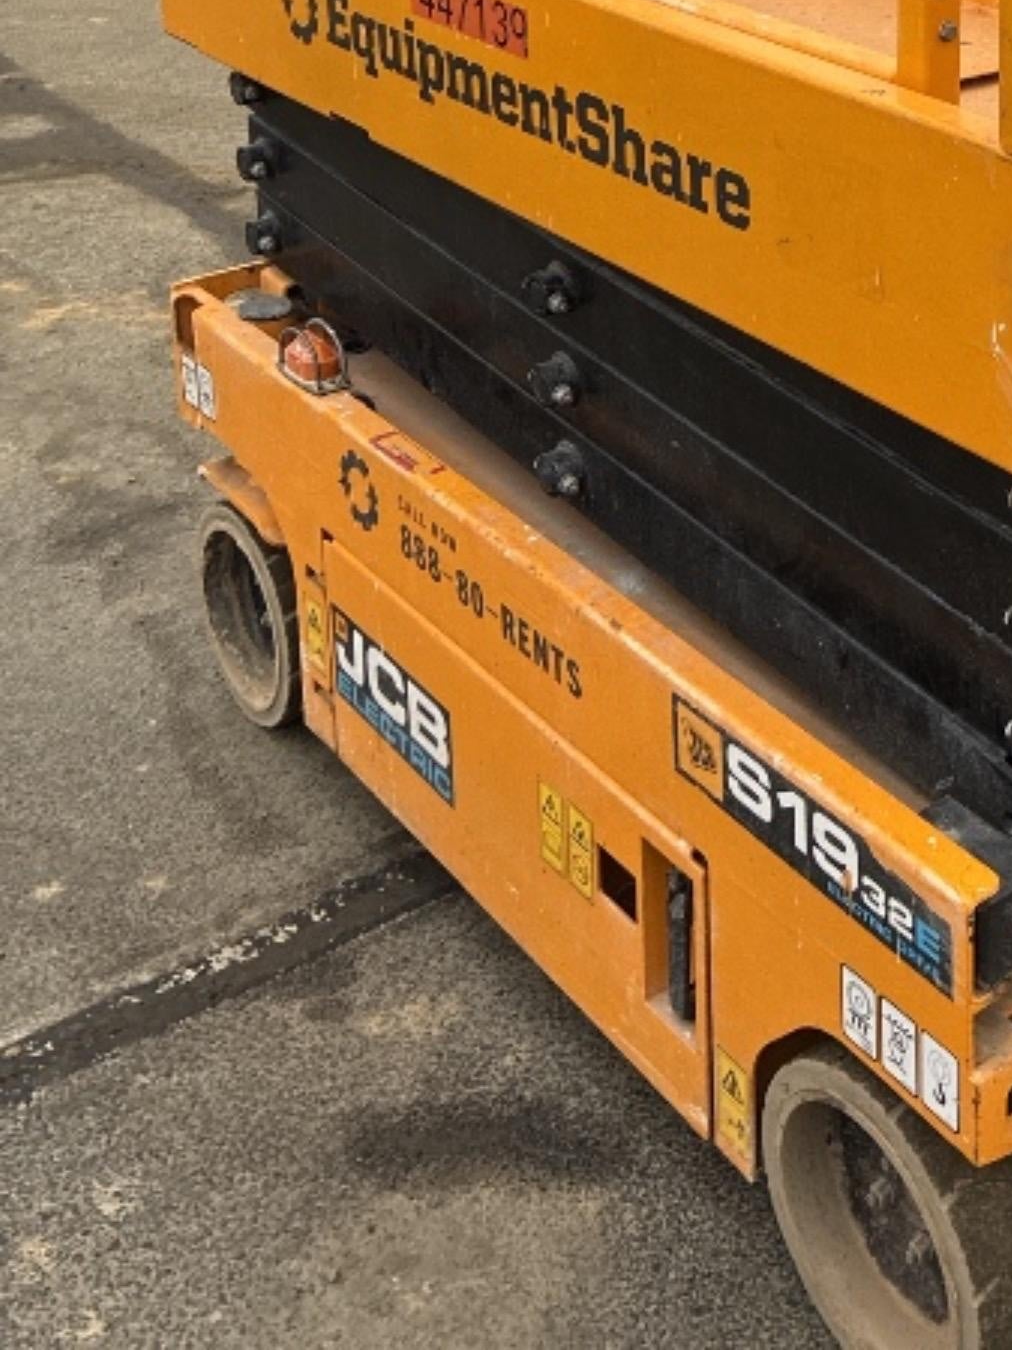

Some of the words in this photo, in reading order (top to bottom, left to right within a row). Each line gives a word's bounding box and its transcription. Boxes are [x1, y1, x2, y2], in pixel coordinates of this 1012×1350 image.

[400, 524, 583, 699] 888-80-RENTS
[336, 629, 450, 769] JCB
[338, 671, 451, 800] ELECTRIC
